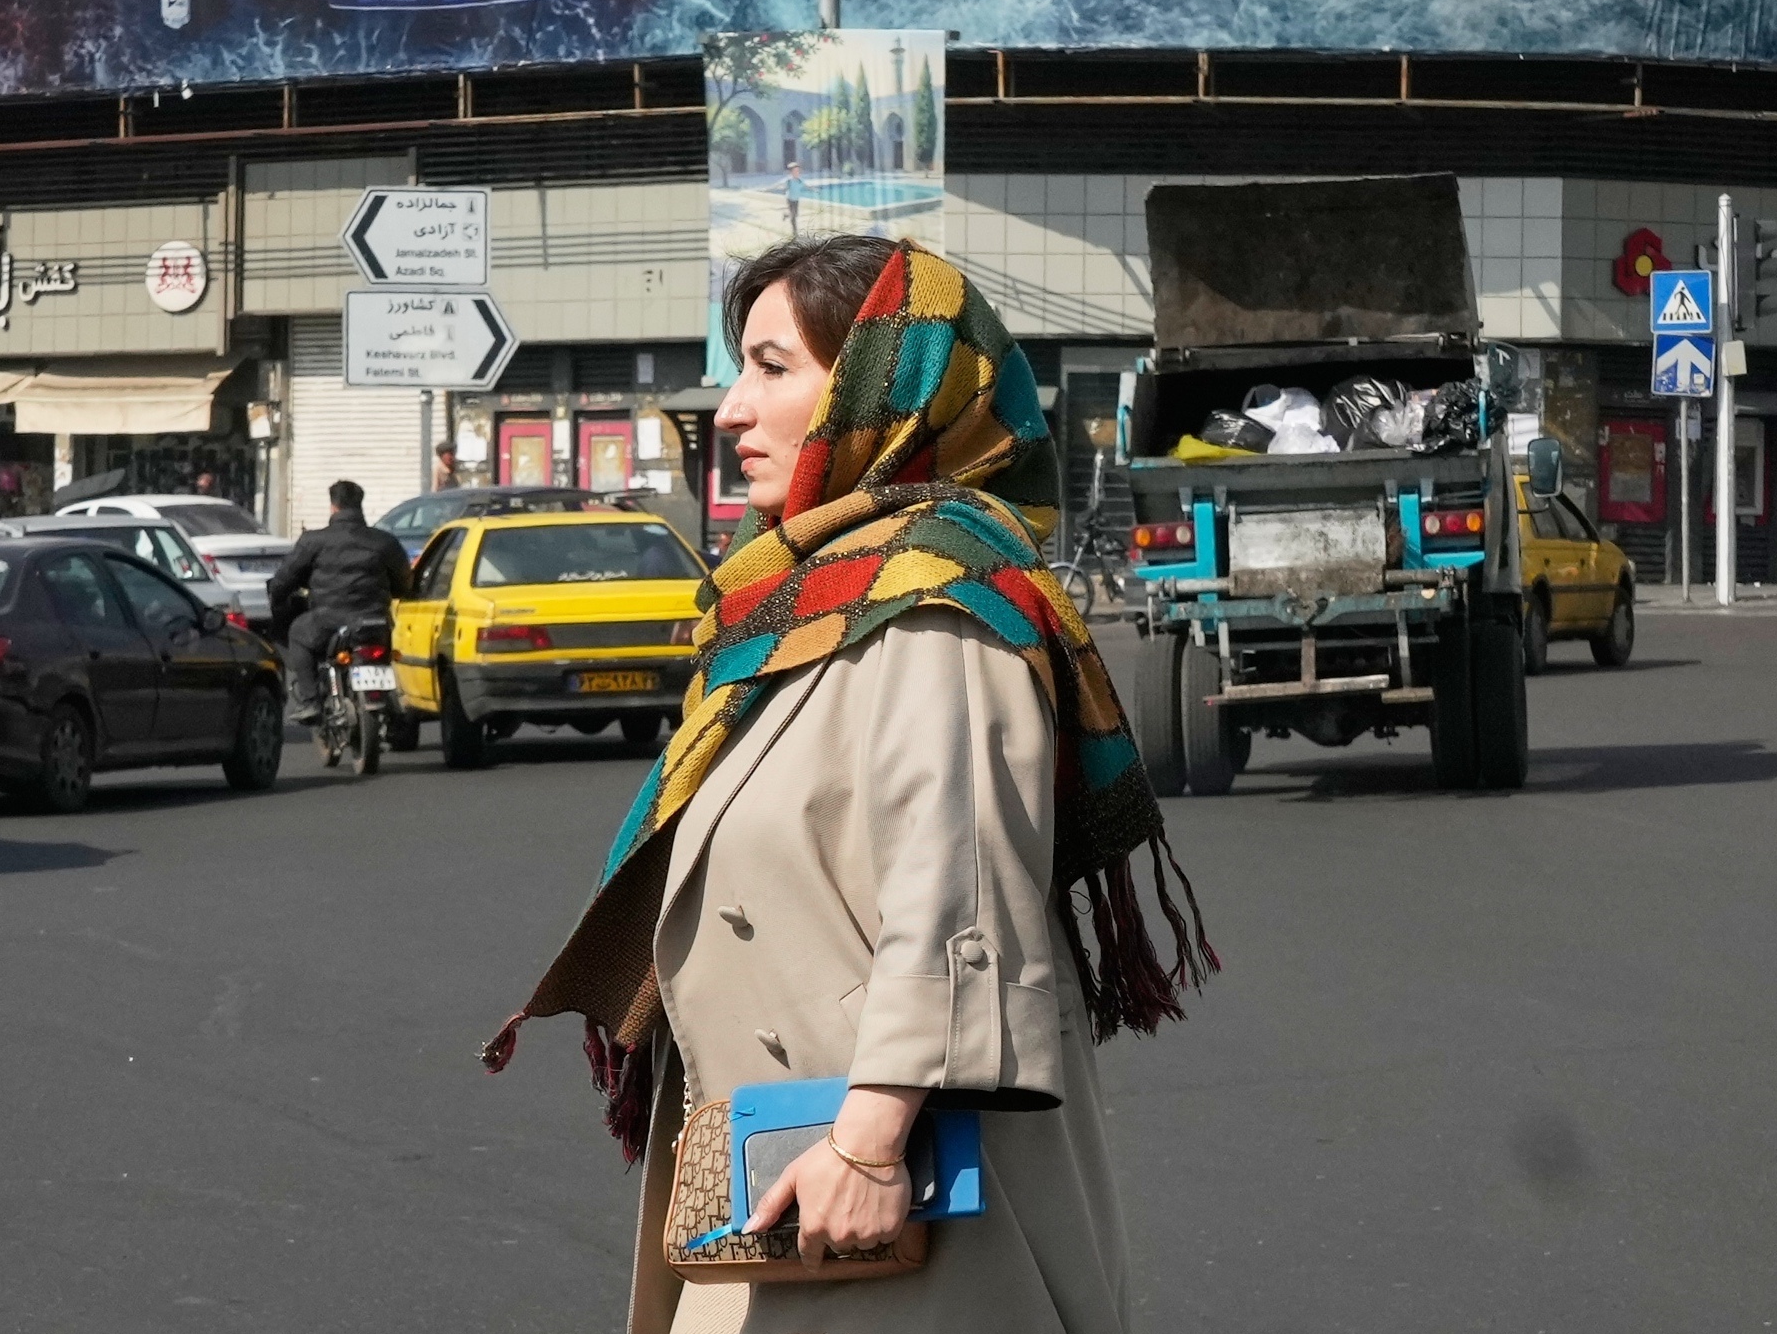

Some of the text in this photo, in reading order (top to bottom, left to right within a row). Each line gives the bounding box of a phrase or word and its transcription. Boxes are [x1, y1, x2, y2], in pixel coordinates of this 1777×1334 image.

[396, 197, 457, 212] جمالزاده
[413, 222, 456, 240] آزادی
[395, 266, 426, 277] Azadi
[19, 261, 77, 303] کفش
[387, 298, 436, 314] کشاورز
